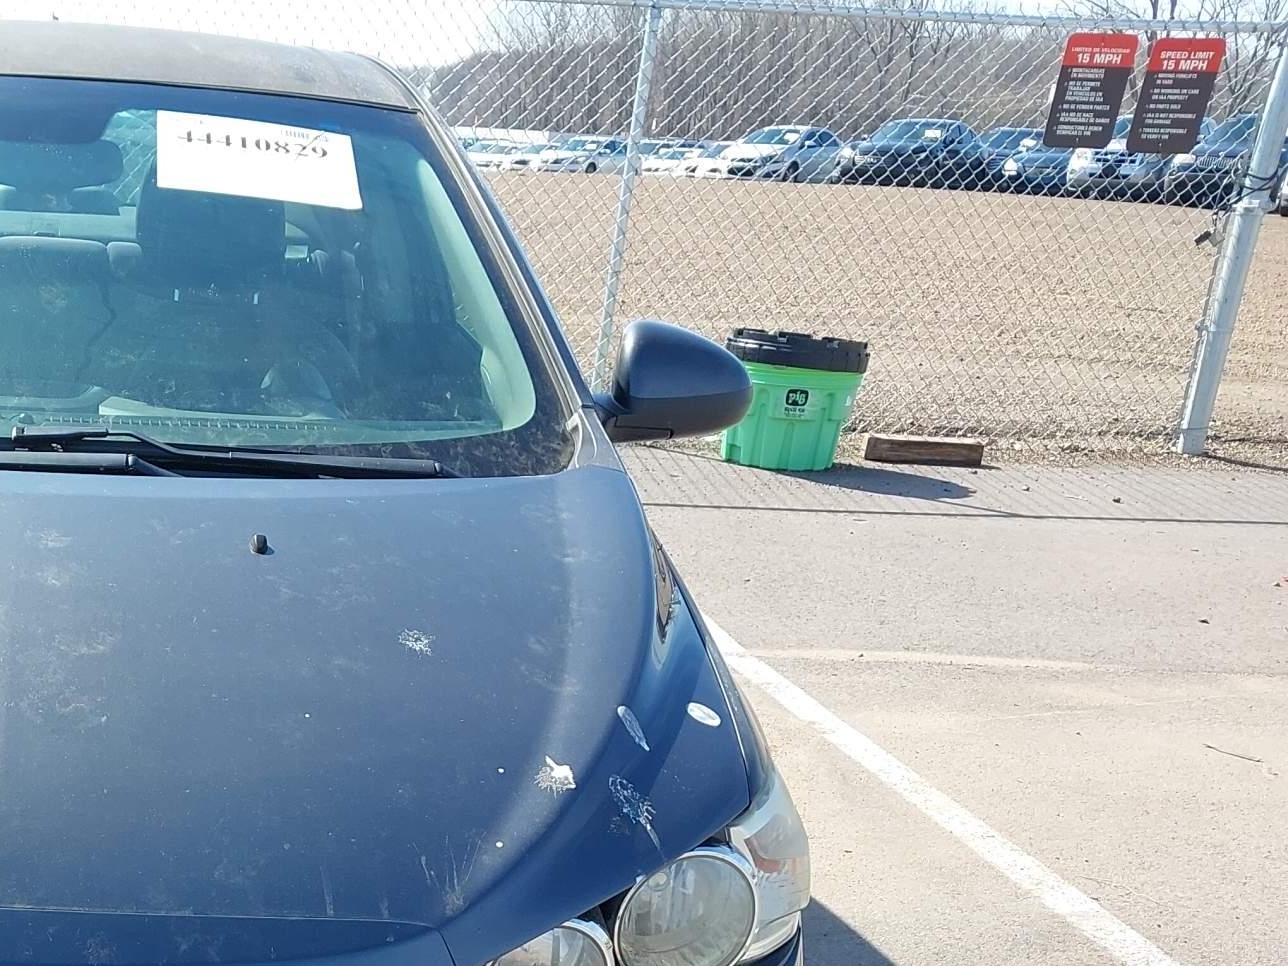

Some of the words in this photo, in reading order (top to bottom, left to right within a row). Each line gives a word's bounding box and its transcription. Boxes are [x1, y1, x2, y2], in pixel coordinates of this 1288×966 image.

[1077, 53, 1091, 64] 15
[1093, 53, 1122, 65] MPH
[1160, 51, 1188, 59] SPEED
[1190, 51, 1215, 60] LIMIT
[1162, 60, 1176, 70] 15
[1178, 60, 1208, 71] MPH
[177, 130, 328, 159] 44410829
[788, 391, 807, 405] pig
